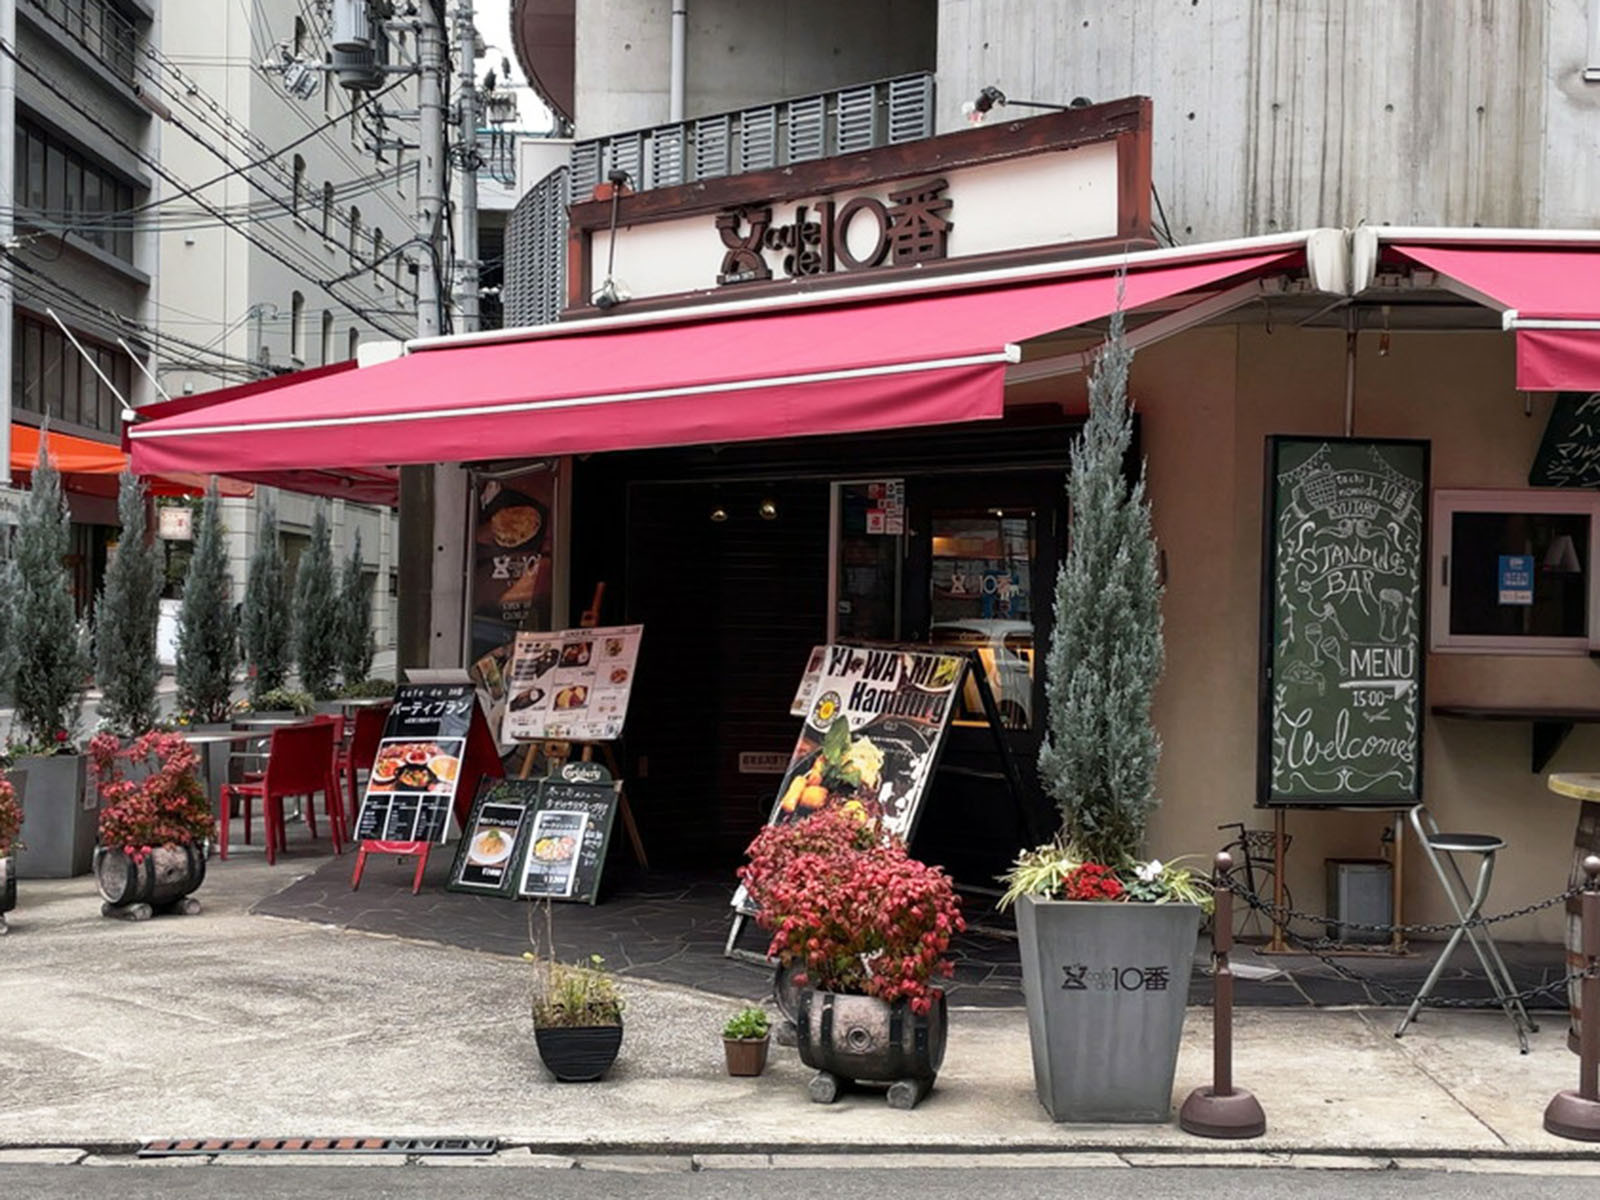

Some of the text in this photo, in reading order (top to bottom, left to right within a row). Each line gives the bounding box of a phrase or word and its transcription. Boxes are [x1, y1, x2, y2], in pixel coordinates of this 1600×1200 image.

[763, 205, 821, 250] cafe
[1320, 570, 1380, 616] BAR
[1350, 648, 1415, 678] MENU
[1281, 708, 1414, 769] Welcome
[1111, 966, 1170, 991] 10番
